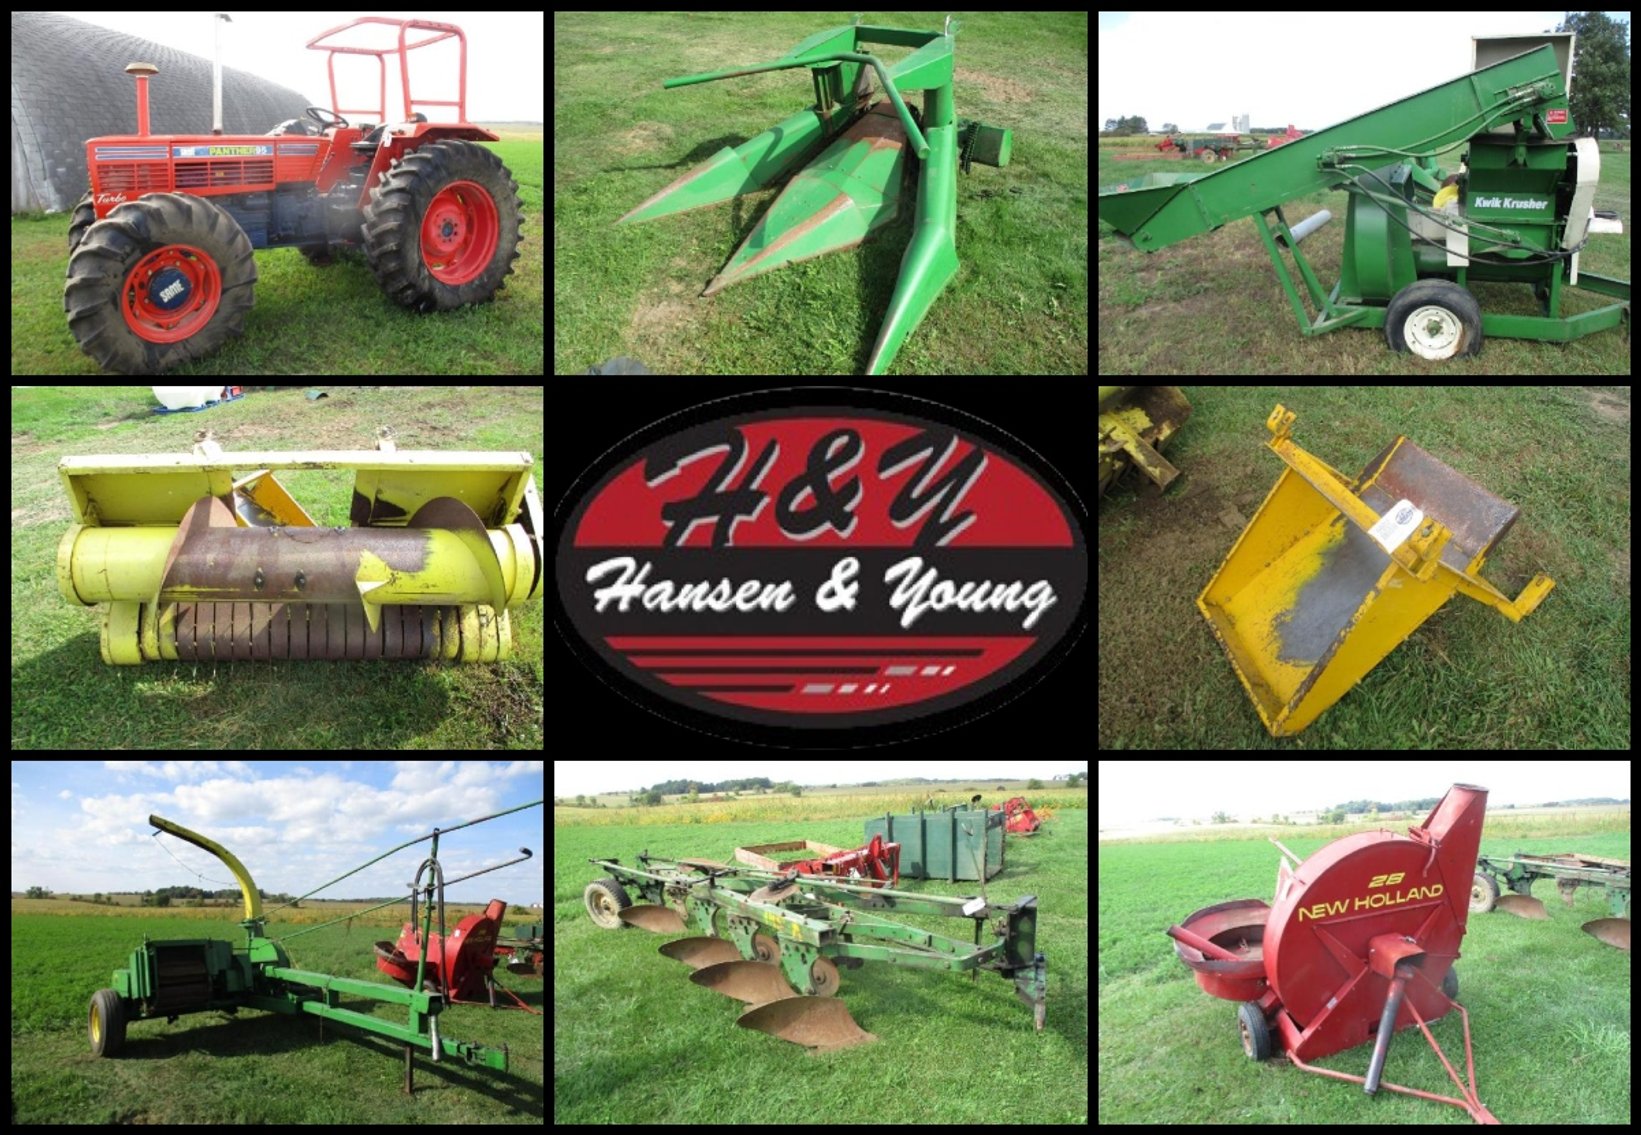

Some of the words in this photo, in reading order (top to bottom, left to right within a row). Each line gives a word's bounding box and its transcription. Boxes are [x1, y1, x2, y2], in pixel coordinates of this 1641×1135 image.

[96, 192, 127, 204] Turbo
[1474, 196, 1501, 208] Kwik
[1503, 197, 1548, 209] Krusher
[159, 279, 184, 303] SAME
[1368, 872, 1405, 888] 28
[1298, 899, 1349, 921] NEW
[1354, 884, 1443, 910] HOLLAND
